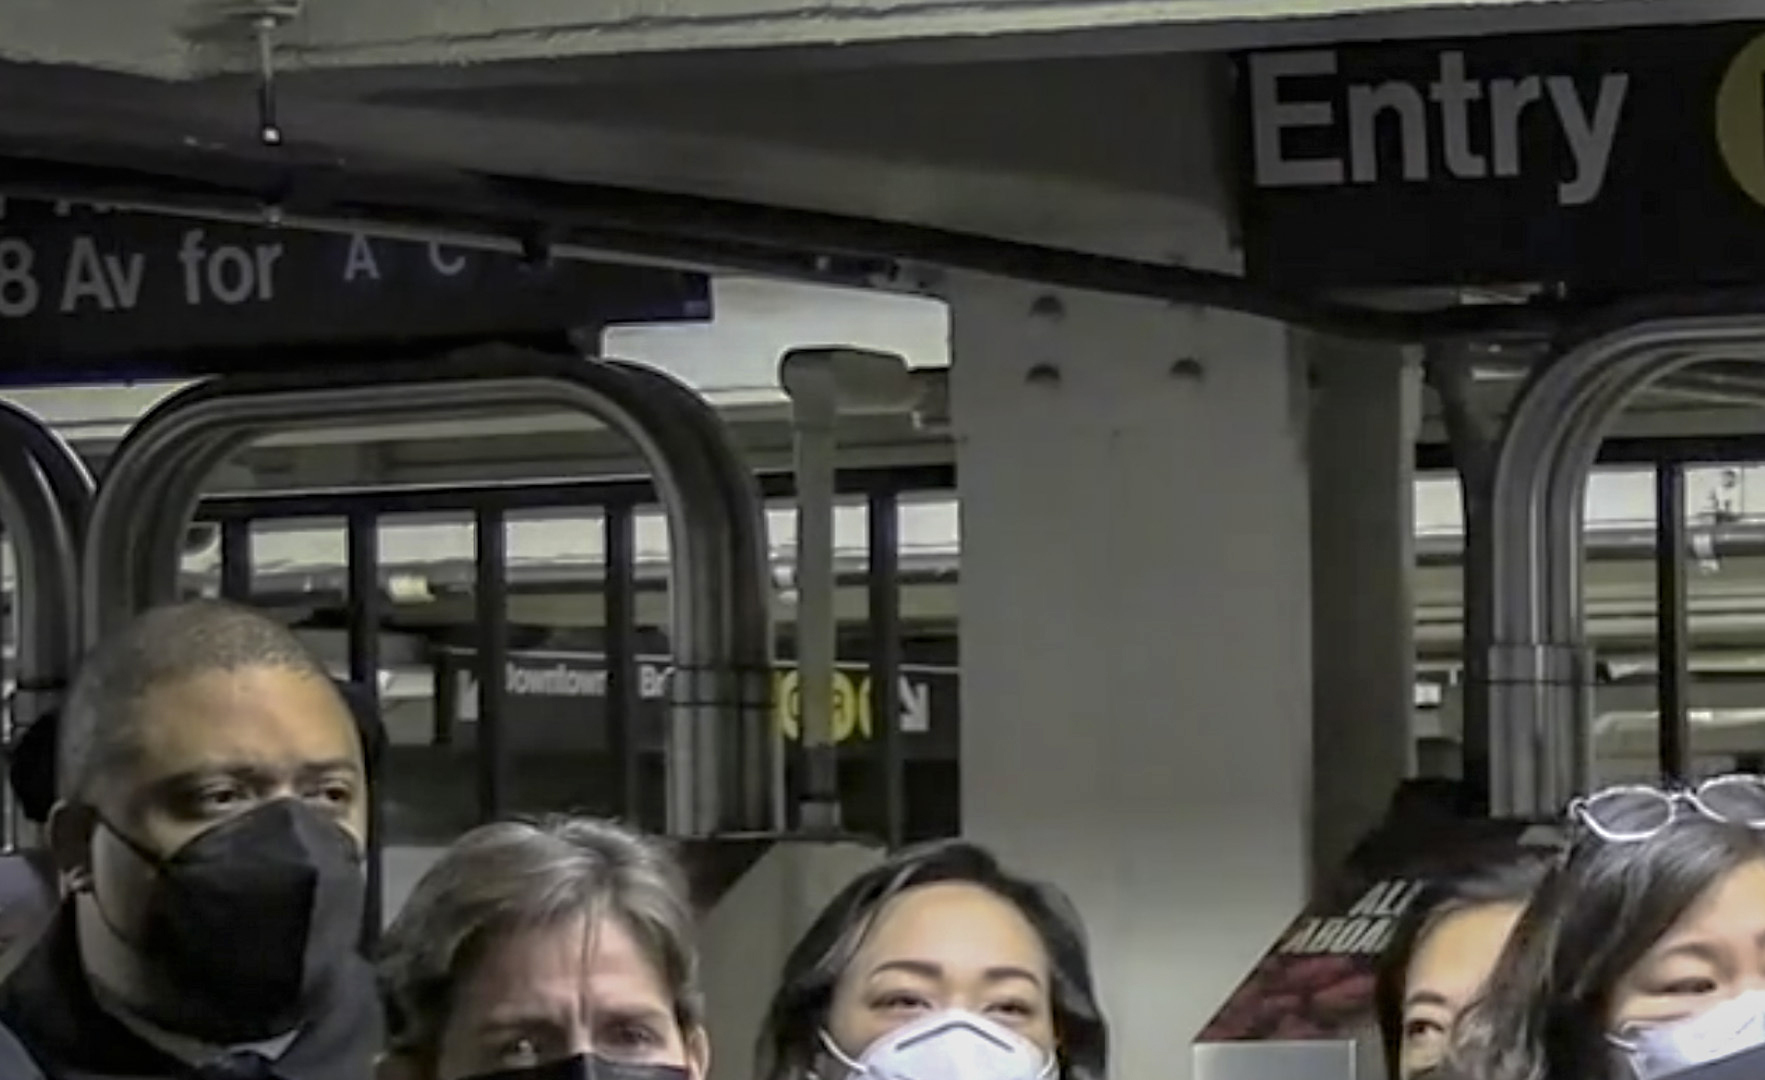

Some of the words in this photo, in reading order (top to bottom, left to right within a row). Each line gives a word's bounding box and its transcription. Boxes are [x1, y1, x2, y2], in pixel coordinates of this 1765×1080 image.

[1249, 50, 1629, 205] Entry
[0, 236, 39, 318] 8
[60, 234, 145, 312] Av
[179, 227, 284, 306] for
[343, 232, 381, 282] A
